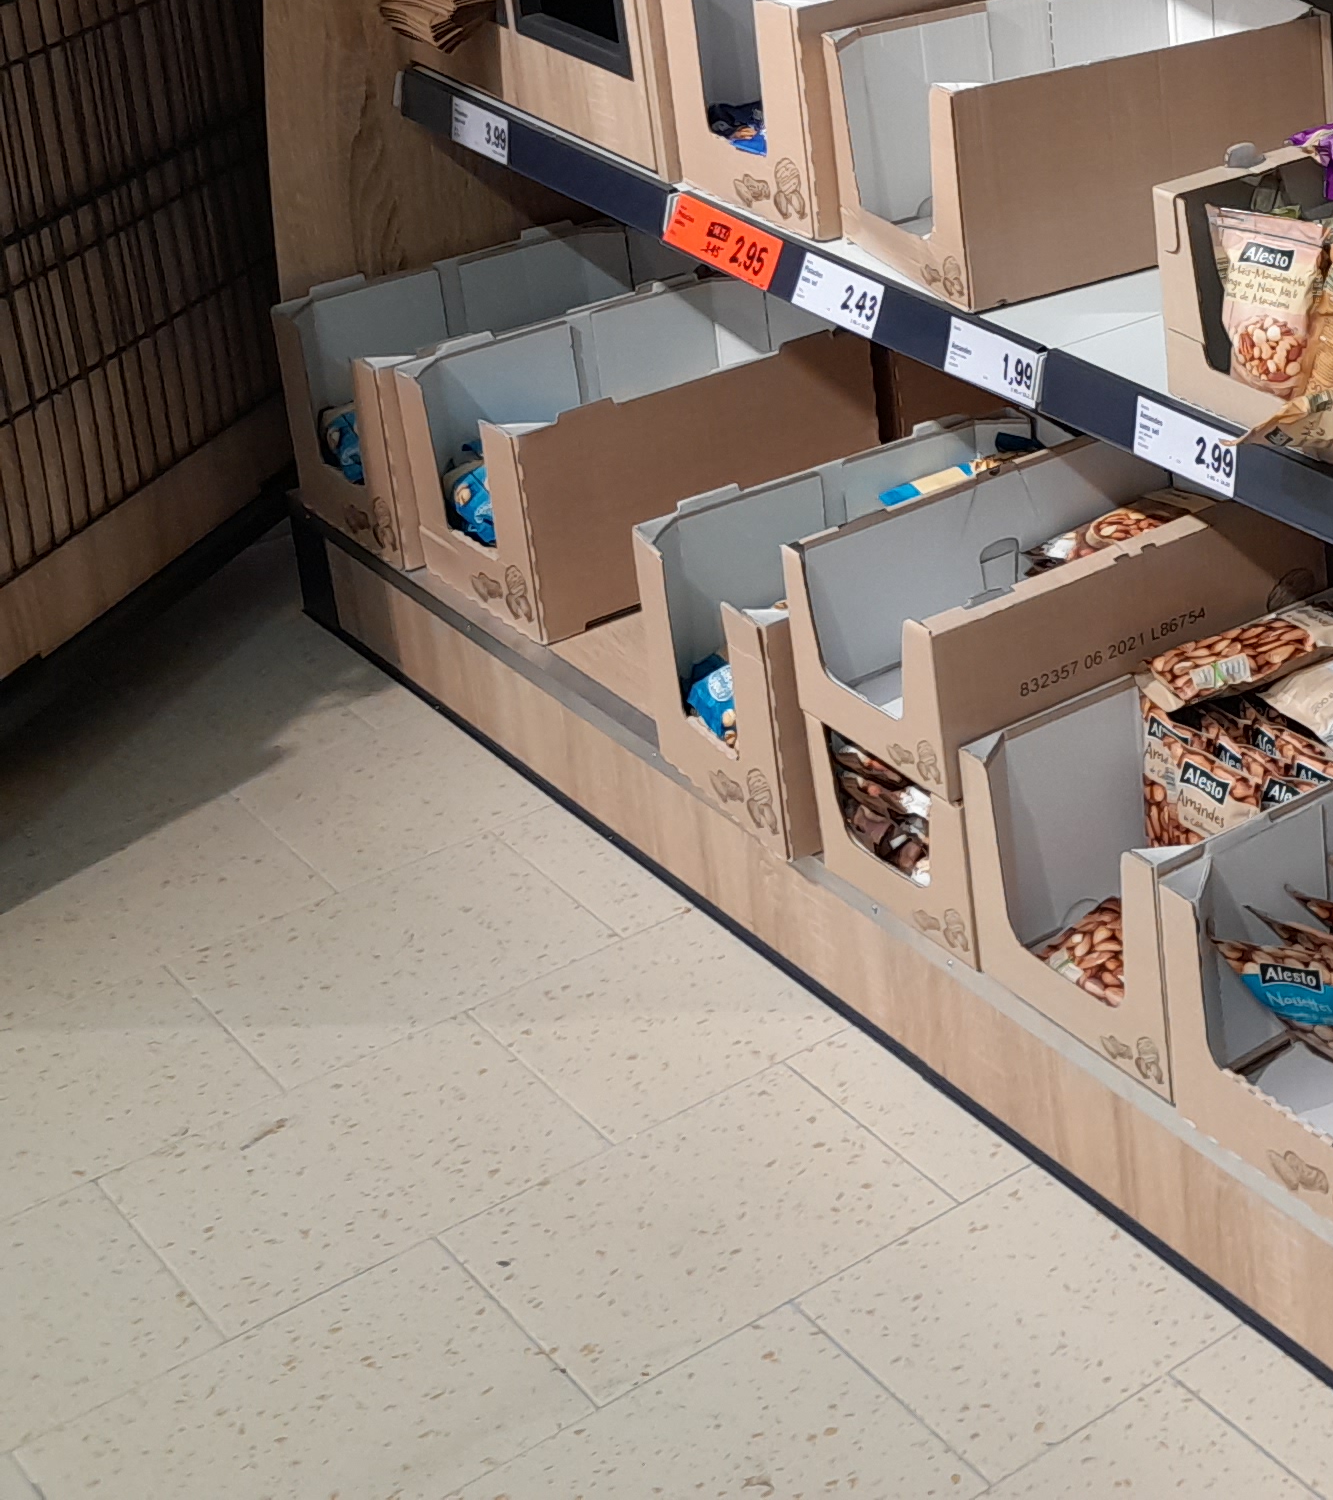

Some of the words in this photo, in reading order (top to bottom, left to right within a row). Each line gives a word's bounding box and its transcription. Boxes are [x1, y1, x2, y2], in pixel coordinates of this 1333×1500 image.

[729, 235, 769, 277] 2.95
[1243, 246, 1289, 268] Alesto
[840, 284, 878, 322] 2.43
[1002, 353, 1033, 390] 1,99
[1195, 436, 1234, 479] 2.99
[1020, 660, 1079, 697] 832357
[1084, 650, 1103, 669] 06
[1108, 632, 1145, 660] 2021
[1151, 607, 1206, 641] L86754
[1183, 766, 1223, 800] Alesto
[1177, 788, 1226, 828] Amandes
[1265, 967, 1317, 988] Alesto
